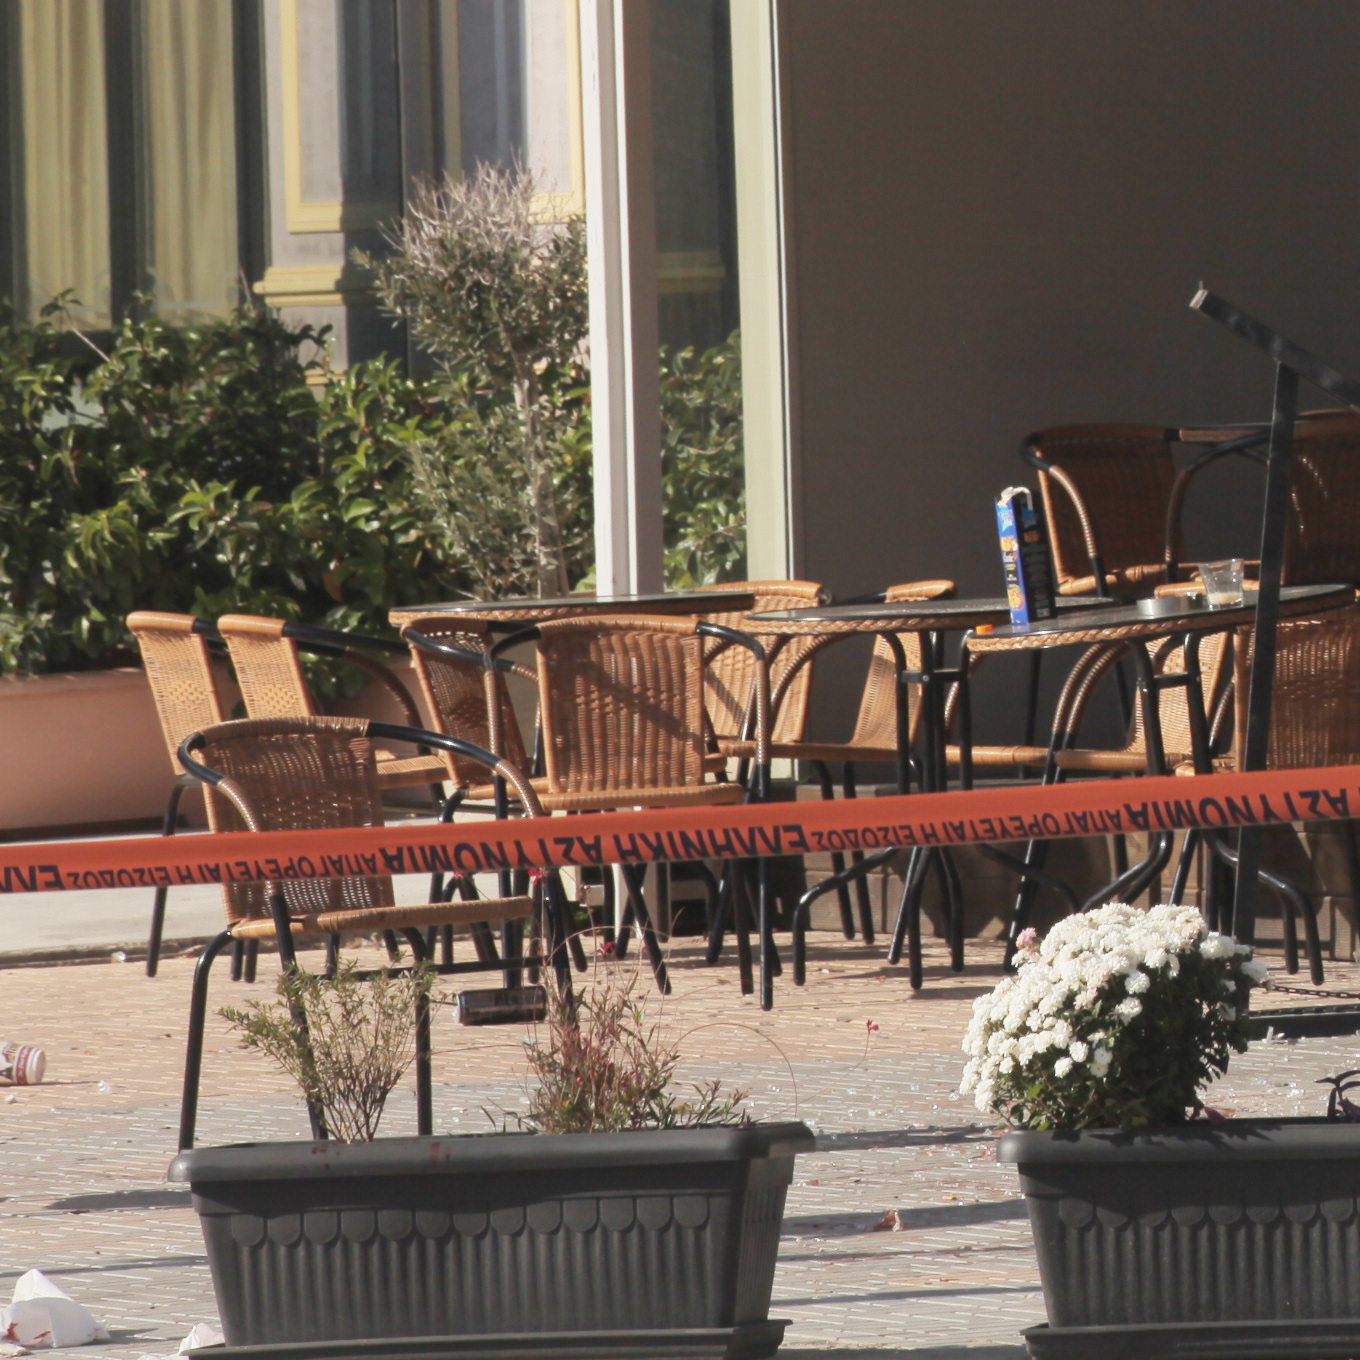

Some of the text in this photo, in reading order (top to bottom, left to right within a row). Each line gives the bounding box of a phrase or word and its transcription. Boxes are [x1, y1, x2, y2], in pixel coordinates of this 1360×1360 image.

[939, 809, 1124, 844] ΑΠΑΓΟΡΕΥΕΤΑΙ
[1125, 787, 1349, 831] ΑΣΤΥΝΟΜΙΑ
[380, 835, 604, 874] ΑΣΤΥΝΟΜΙΑ
[613, 824, 805, 865] ΕΛΛΗΝΙΚΗ
[810, 823, 918, 850] ΕΙΣΟΔΟΣ
[197, 851, 378, 884] ΑΠΑΓΟΡΕΥΕΤΑΙ
